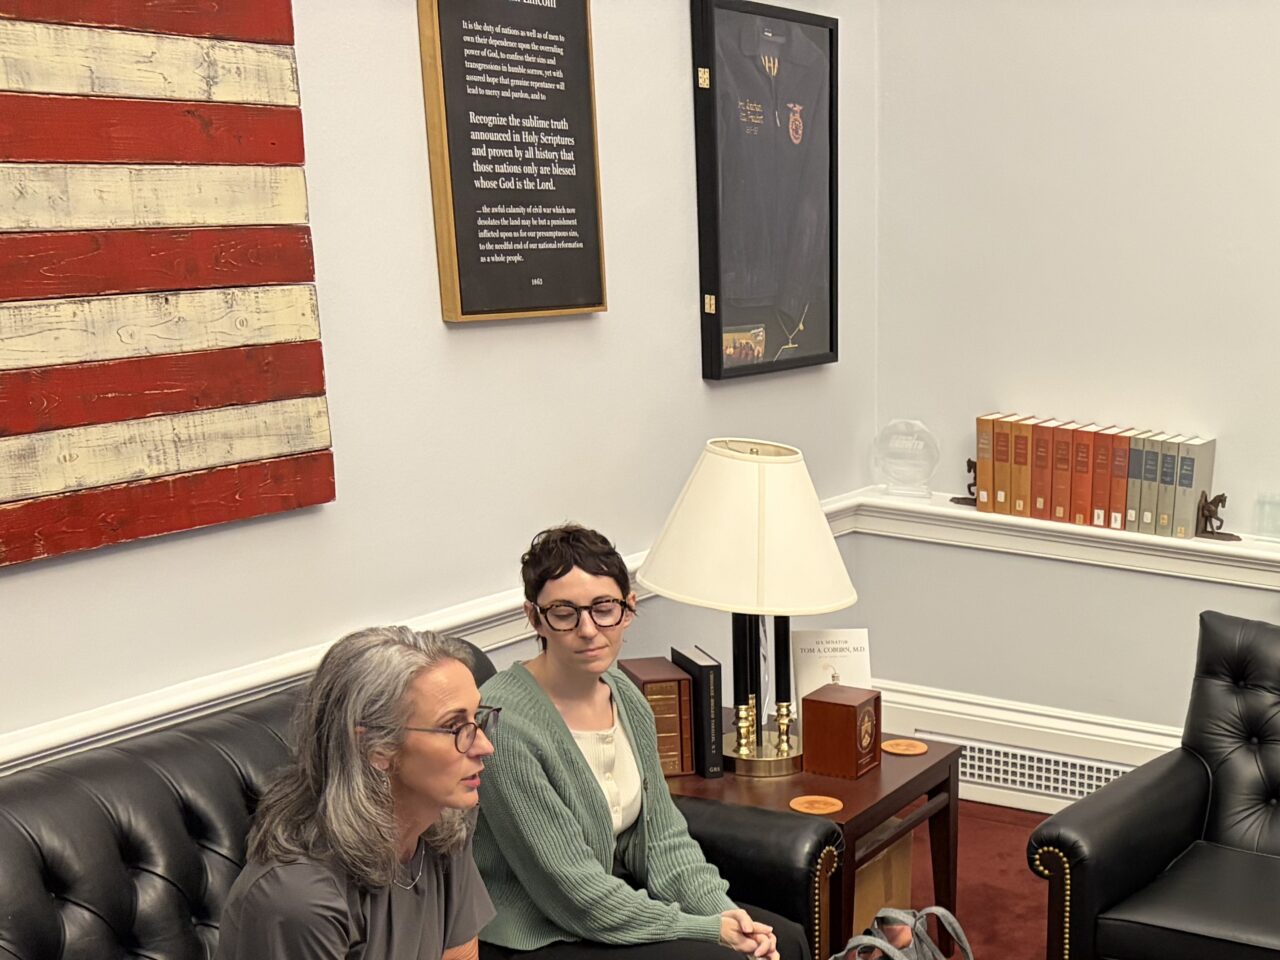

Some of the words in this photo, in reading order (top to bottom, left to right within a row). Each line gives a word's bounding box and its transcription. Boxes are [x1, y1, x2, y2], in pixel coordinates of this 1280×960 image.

[462, 20, 468, 29] It
[468, 21, 473, 29] is
[474, 22, 483, 31] the
[483, 22, 494, 33] duty
[501, 26, 520, 35] nations
[526, 30, 536, 38] well
[543, 31, 549, 40] of
[475, 35, 488, 44] their
[488, 36, 517, 47] dependence
[518, 42, 531, 50] upon
[531, 42, 539, 50] the
[464, 48, 480, 57] power
[481, 48, 487, 56] of
[487, 49, 500, 59] God,
[524, 53, 536, 63] their
[537, 55, 546, 64] sins
[547, 56, 556, 65] and
[465, 60, 501, 71] transgressions
[502, 64, 507, 72] in
[508, 64, 526, 74] humble
[544, 70, 552, 78] yet
[552, 69, 564, 78] with
[466, 74, 486, 82] assured
[486, 74, 498, 85] hope
[500, 76, 510, 85] that
[556, 82, 565, 90] will
[466, 85, 478, 95] lead
[485, 89, 500, 98] mercy
[501, 89, 511, 98] and
[512, 90, 531, 100] pardon,
[531, 91, 540, 100] and
[469, 112, 508, 128] Recognize
[508, 114, 521, 127] the
[522, 115, 550, 128] sublime
[550, 118, 568, 130] truth
[470, 130, 512, 142] announced
[512, 130, 521, 142] in
[522, 131, 539, 146] Holy
[540, 132, 575, 147] Scriptures
[472, 144, 486, 156] and
[488, 148, 514, 160] proven
[514, 146, 523, 161] by
[525, 146, 535, 158] all
[535, 147, 559, 162] history
[560, 148, 575, 160] that
[473, 160, 494, 173] those
[495, 162, 522, 174] nations
[523, 162, 538, 177] only
[540, 166, 551, 175] are
[552, 163, 576, 176] blessed
[474, 176, 498, 189] whose
[499, 177, 515, 189] God
[516, 178, 523, 189] is
[523, 178, 535, 190] the
[537, 178, 556, 190] Lord.
[506, 205, 526, 215] calamity
[527, 205, 532, 213] of
[532, 205, 542, 213] civil
[501, 217, 509, 225] the
[532, 217, 538, 225] be
[551, 218, 577, 227] punishment
[478, 230, 499, 238] inflicted
[500, 231, 513, 239] upon
[486, 241, 494, 250] the
[495, 241, 513, 250] needful
[514, 241, 522, 249] end
[523, 241, 529, 249] of
[538, 241, 557, 249] national
[557, 241, 583, 249] reformation
[491, 254, 506, 262] whole
